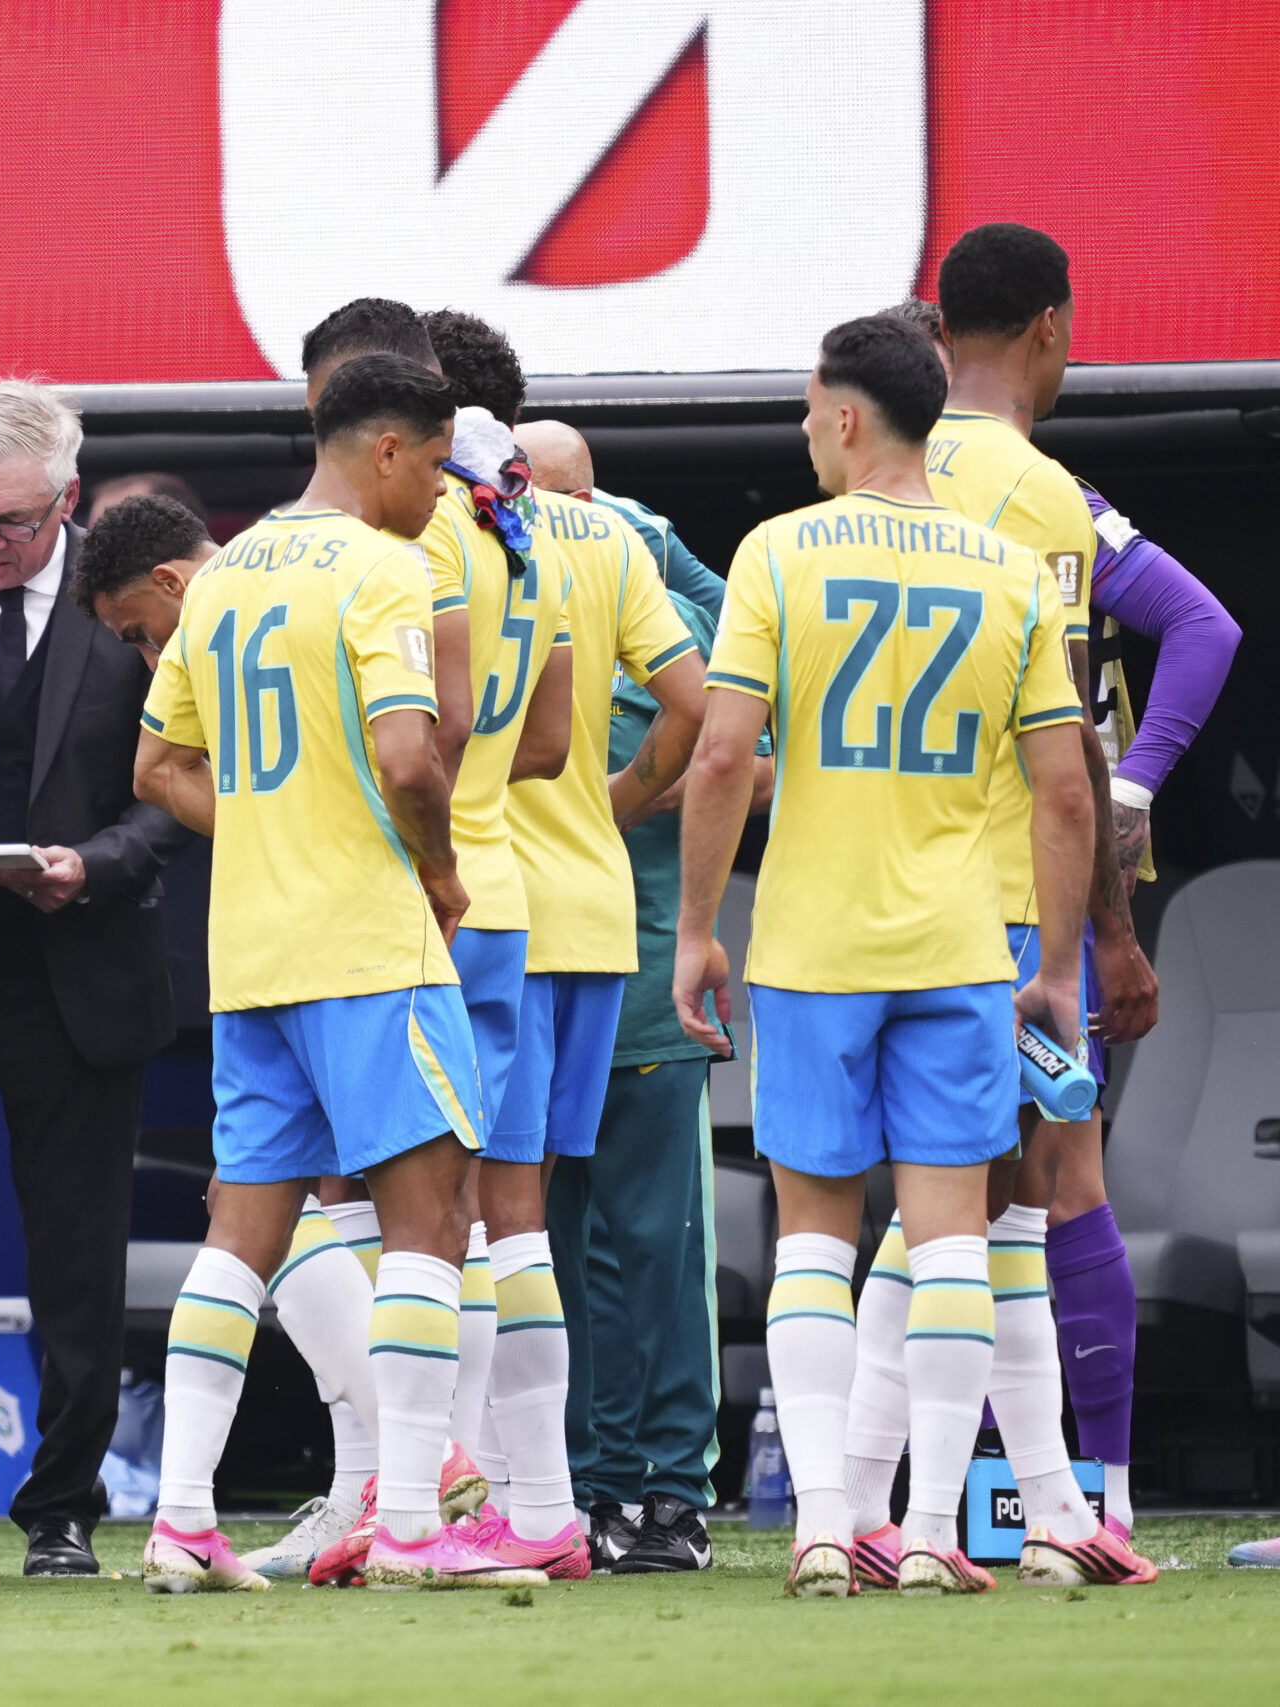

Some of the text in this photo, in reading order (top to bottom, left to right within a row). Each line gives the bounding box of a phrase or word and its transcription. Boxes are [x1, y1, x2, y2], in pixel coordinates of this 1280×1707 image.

[313, 539, 347, 572] S.
[798, 513, 1005, 566] MARTINELLI
[207, 602, 302, 797] 16
[471, 557, 540, 737] 5
[818, 575, 984, 776] 22
